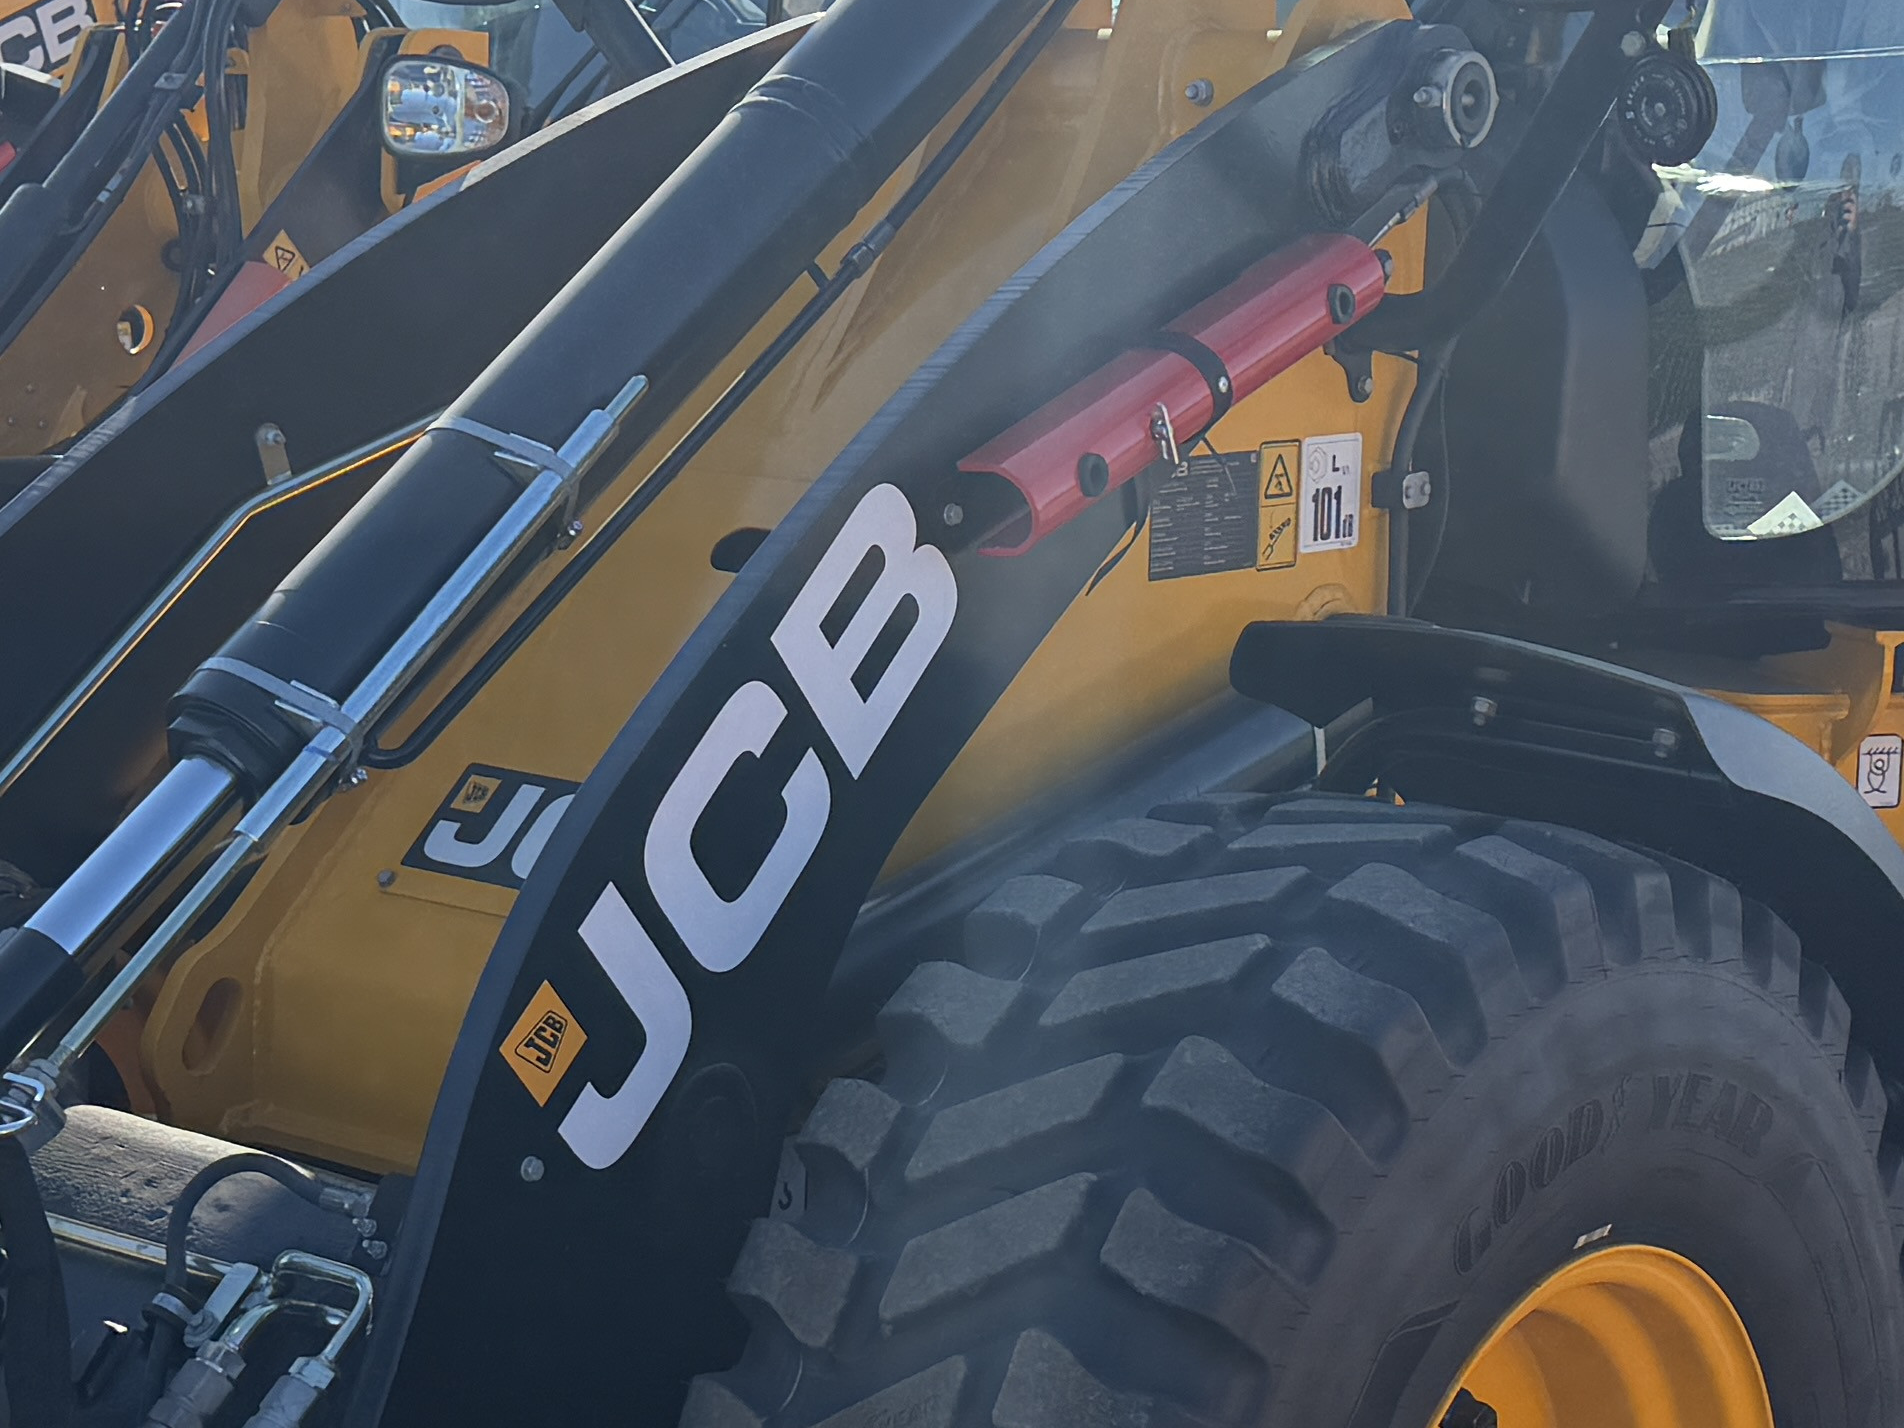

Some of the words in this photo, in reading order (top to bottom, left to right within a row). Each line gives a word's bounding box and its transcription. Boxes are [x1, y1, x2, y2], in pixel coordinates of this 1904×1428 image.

[1312, 484, 1343, 542] 101
[558, 482, 959, 1170] JCB
[523, 1014, 565, 1067] JCB
